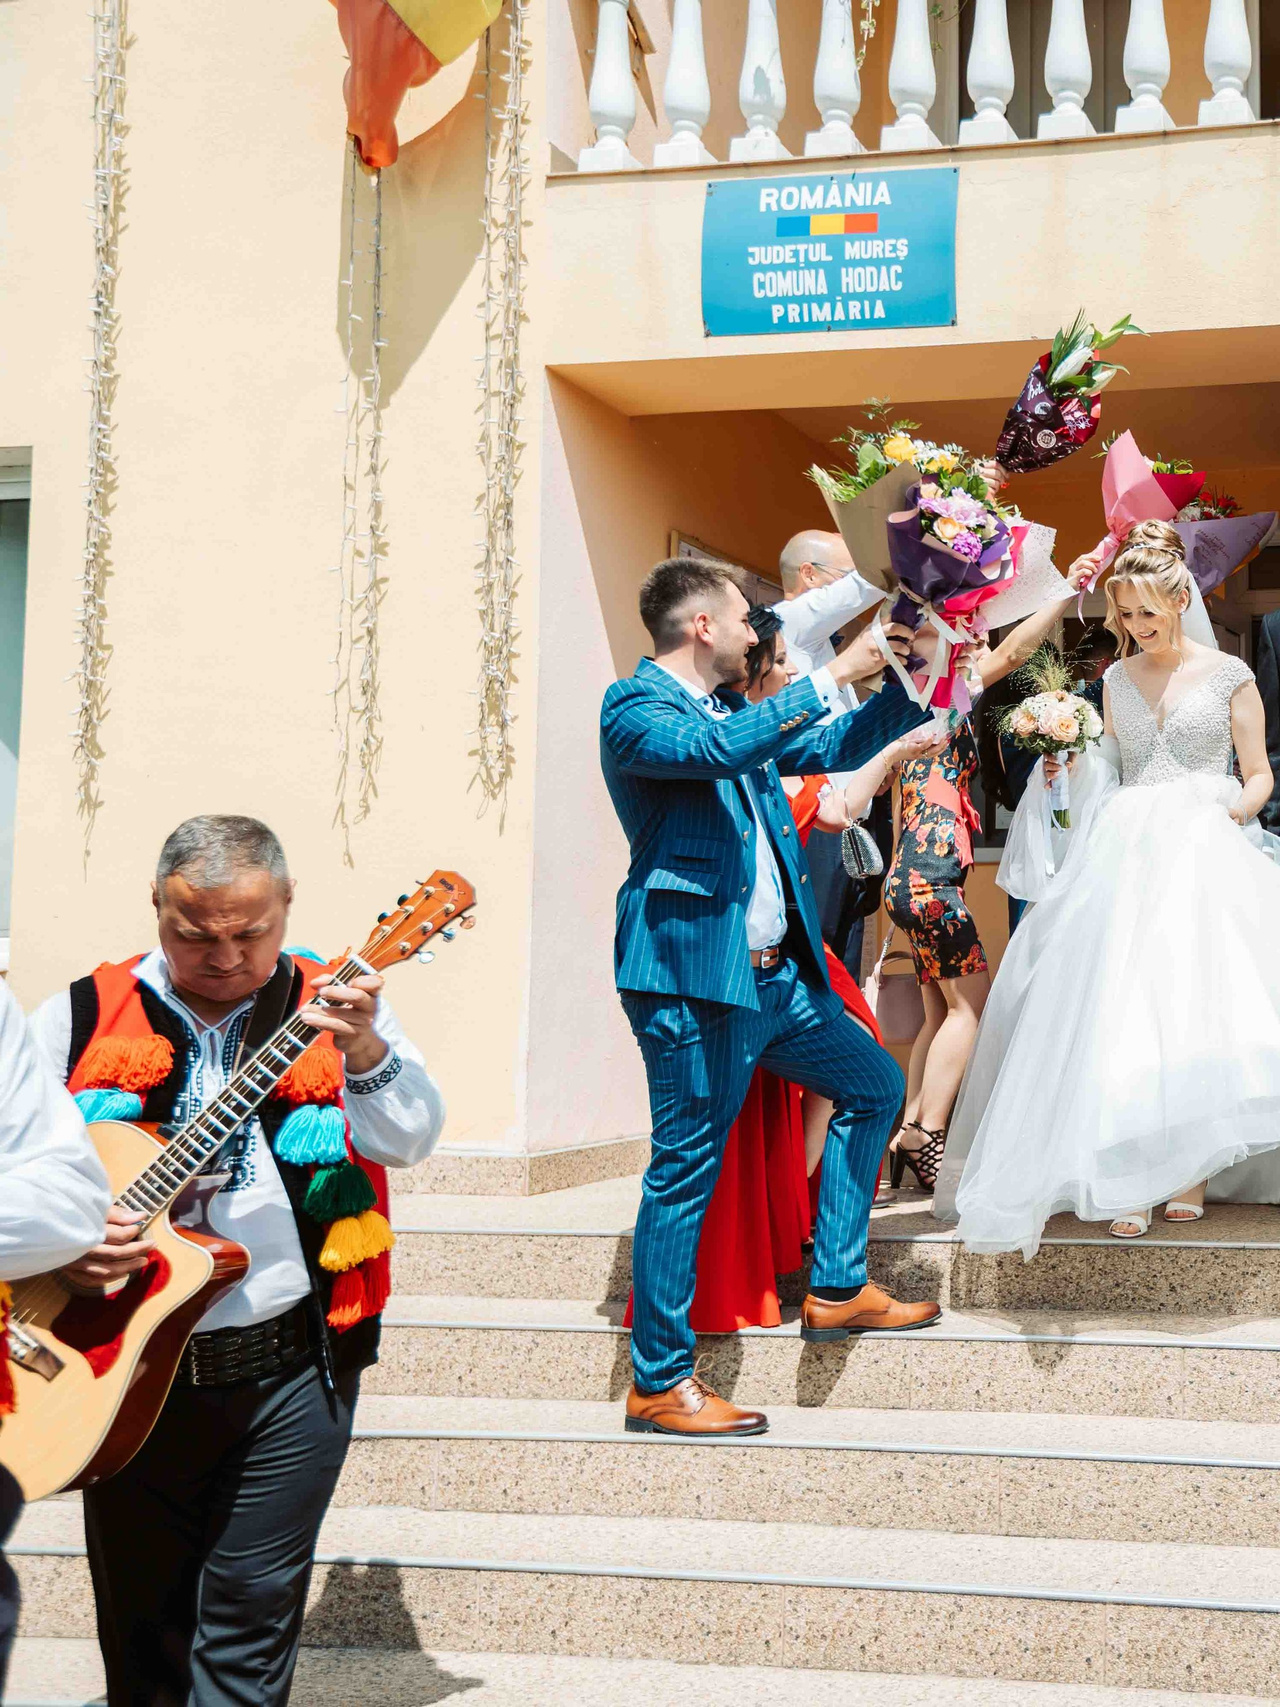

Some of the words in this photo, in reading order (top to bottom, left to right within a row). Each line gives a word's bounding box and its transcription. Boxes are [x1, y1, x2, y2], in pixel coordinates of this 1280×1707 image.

[759, 180, 891, 212] ROMÂNIA
[747, 242, 833, 267] JUDEȚUL
[844, 238, 909, 260] MUREȘ
[752, 268, 828, 299] COMUNA
[841, 264, 903, 294] HODAC
